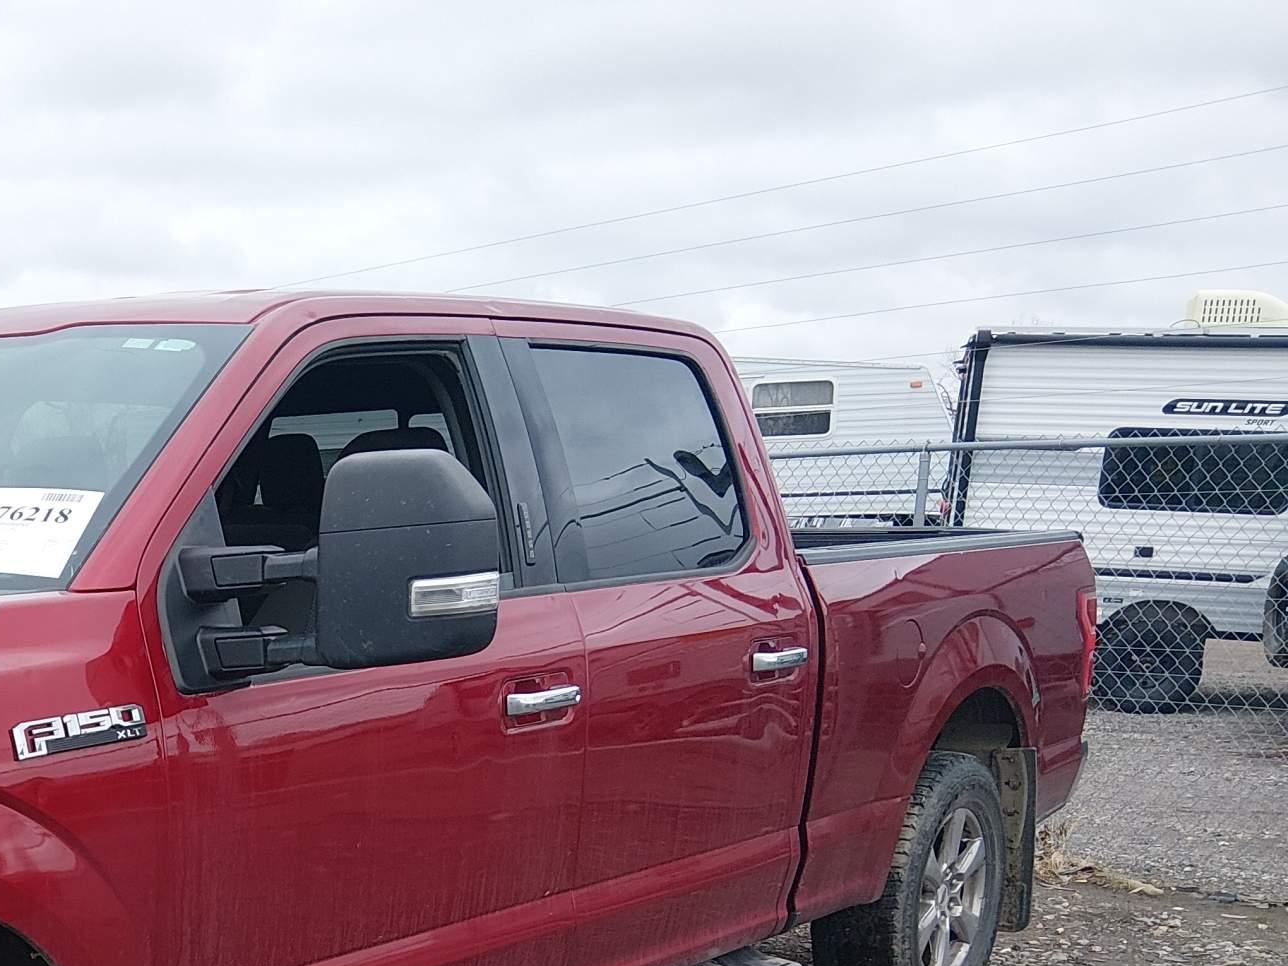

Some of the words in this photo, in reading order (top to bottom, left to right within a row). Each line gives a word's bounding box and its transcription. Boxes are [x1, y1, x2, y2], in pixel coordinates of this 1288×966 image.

[1173, 402, 1224, 413] SUN
[1228, 403, 1286, 414] LITE
[1245, 418, 1276, 426] SPORT
[116, 727, 141, 739] XLT
